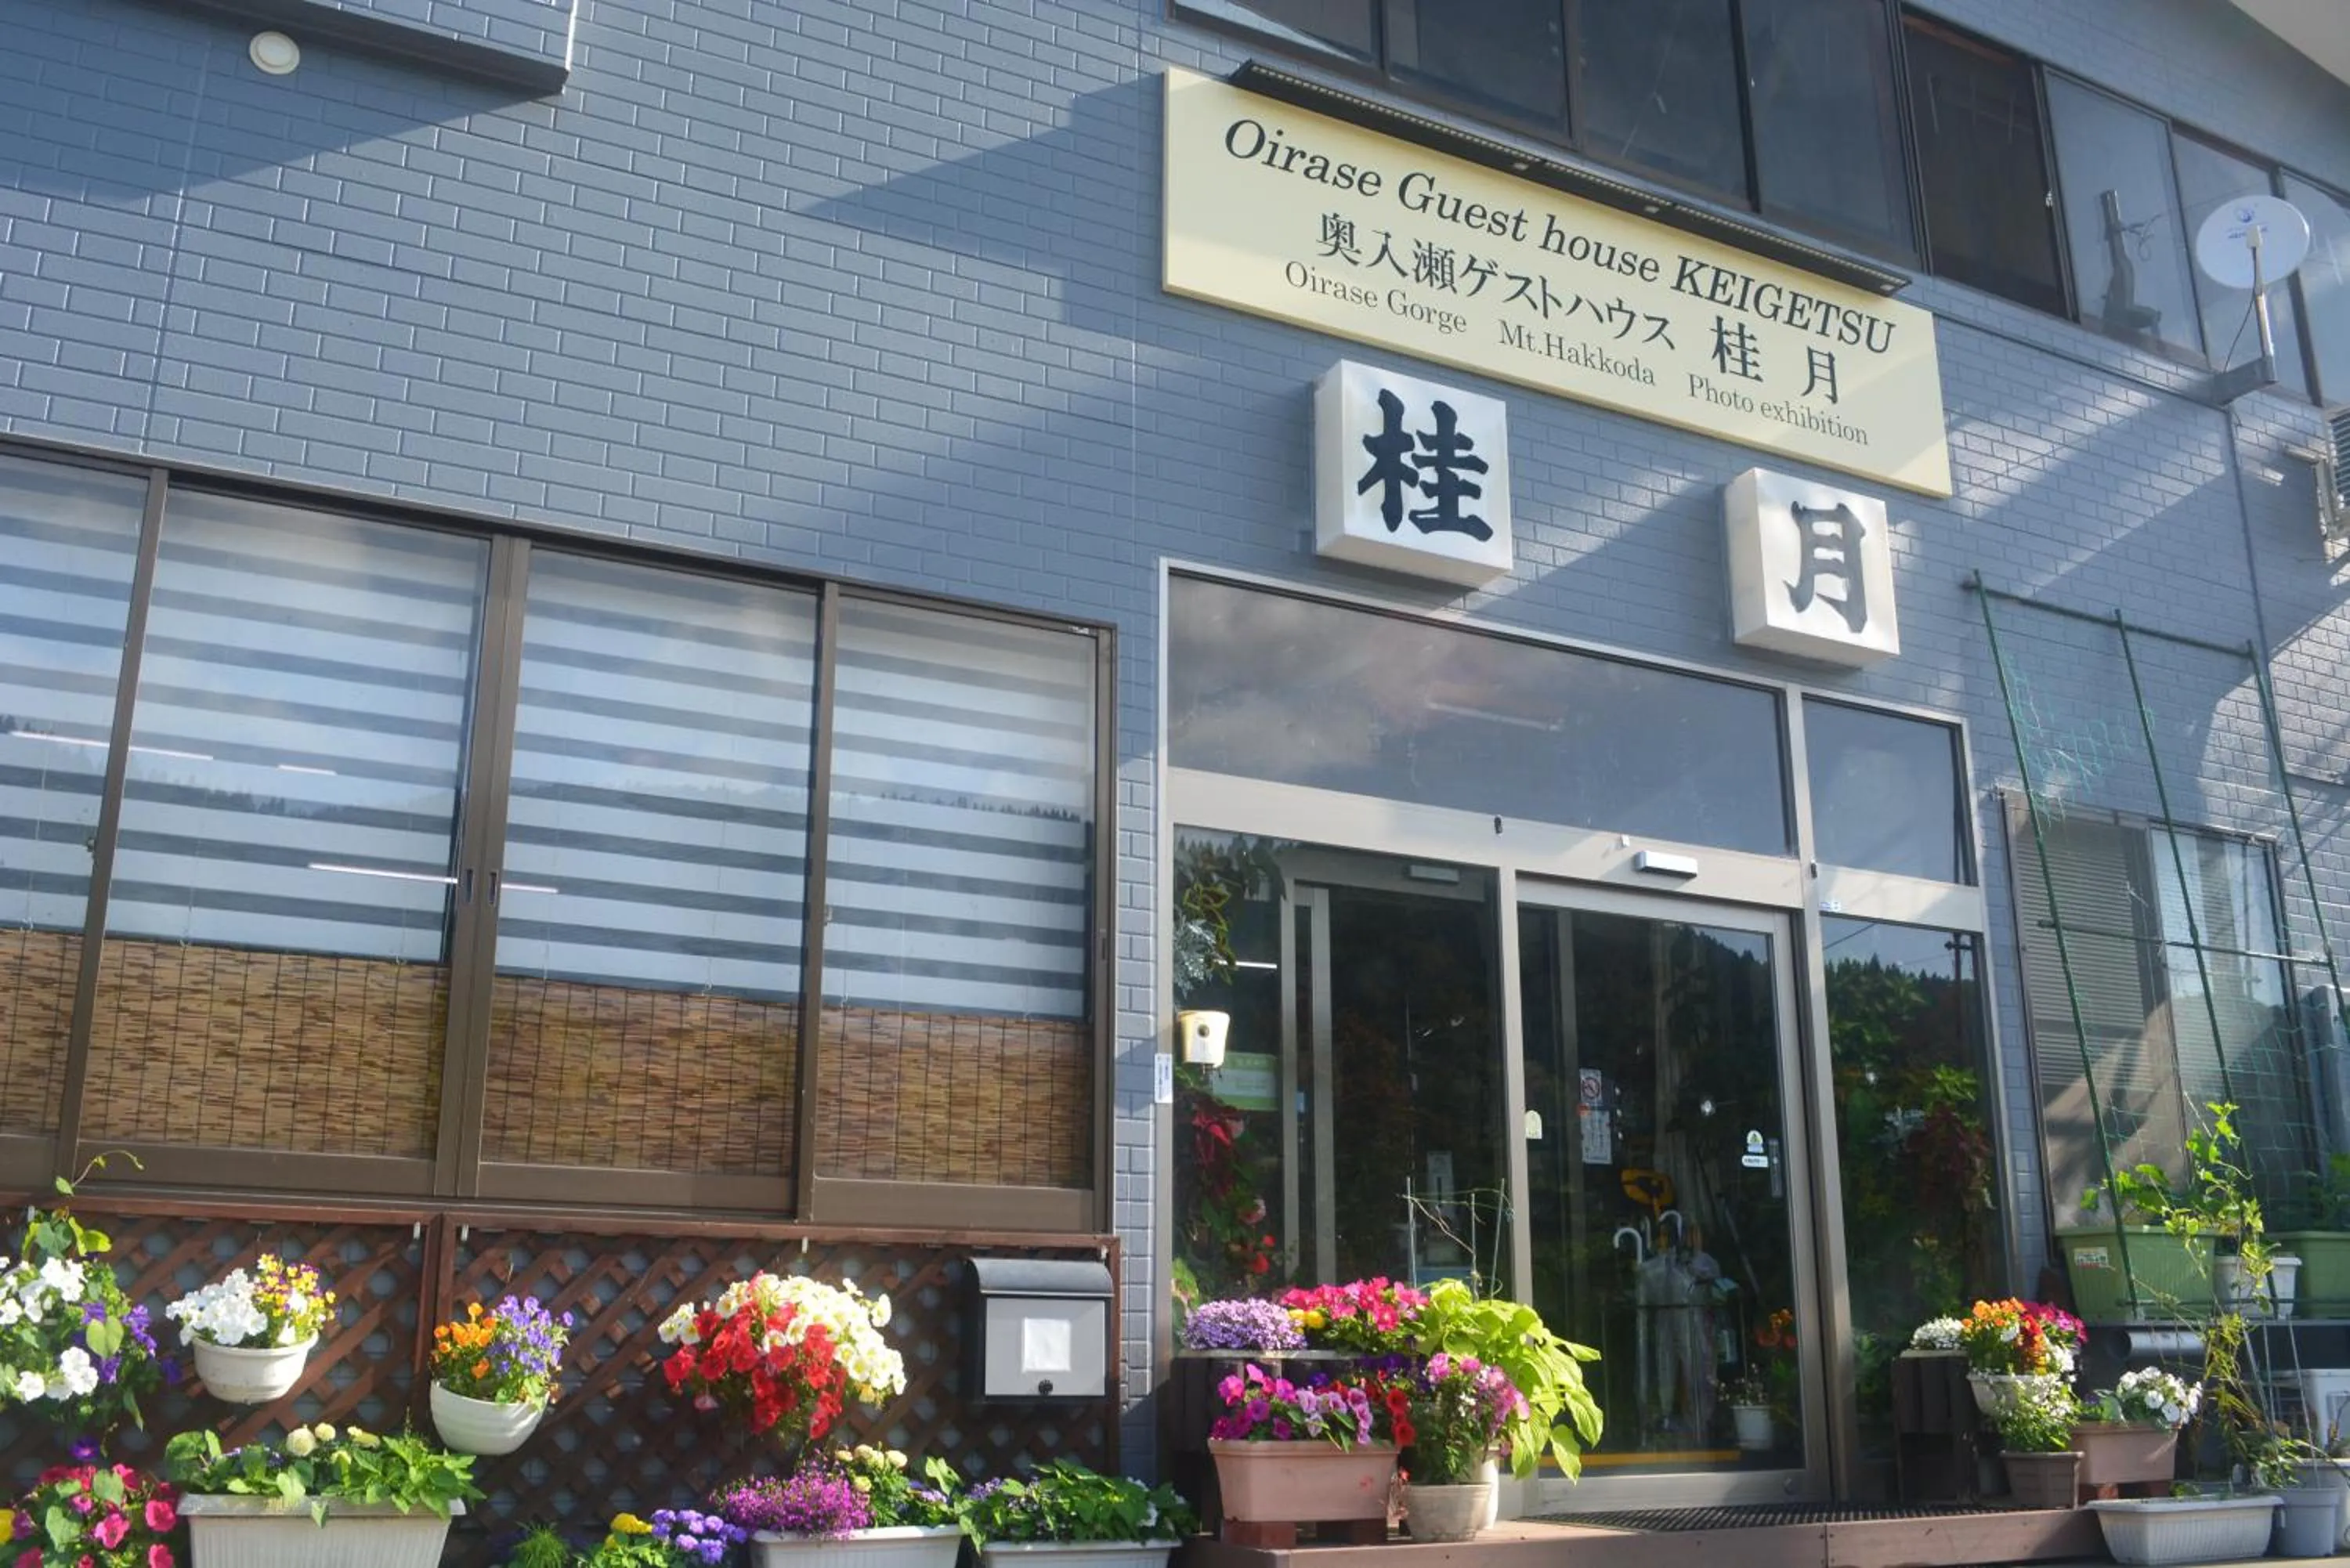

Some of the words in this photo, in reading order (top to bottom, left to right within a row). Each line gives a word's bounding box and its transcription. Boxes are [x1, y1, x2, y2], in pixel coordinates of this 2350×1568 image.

[1225, 119, 1381, 197] Oirase
[1398, 172, 1529, 242] Guest
[1538, 215, 1661, 281] house
[1670, 255, 1896, 353] KEIGETSU
[1316, 212, 1676, 351] 奥入瀬ゲストハウス
[1709, 315, 1763, 383] 桂
[1801, 346, 1838, 404] 月
[1285, 261, 1378, 309] Oirase
[1387, 290, 1467, 334] Gorge
[1499, 320, 1656, 386] Mt.Hakkoda
[1688, 373, 1754, 414] Photo
[1761, 399, 1868, 446] exhibition
[1358, 388, 1493, 542] 桂
[1783, 500, 1867, 634] 月
